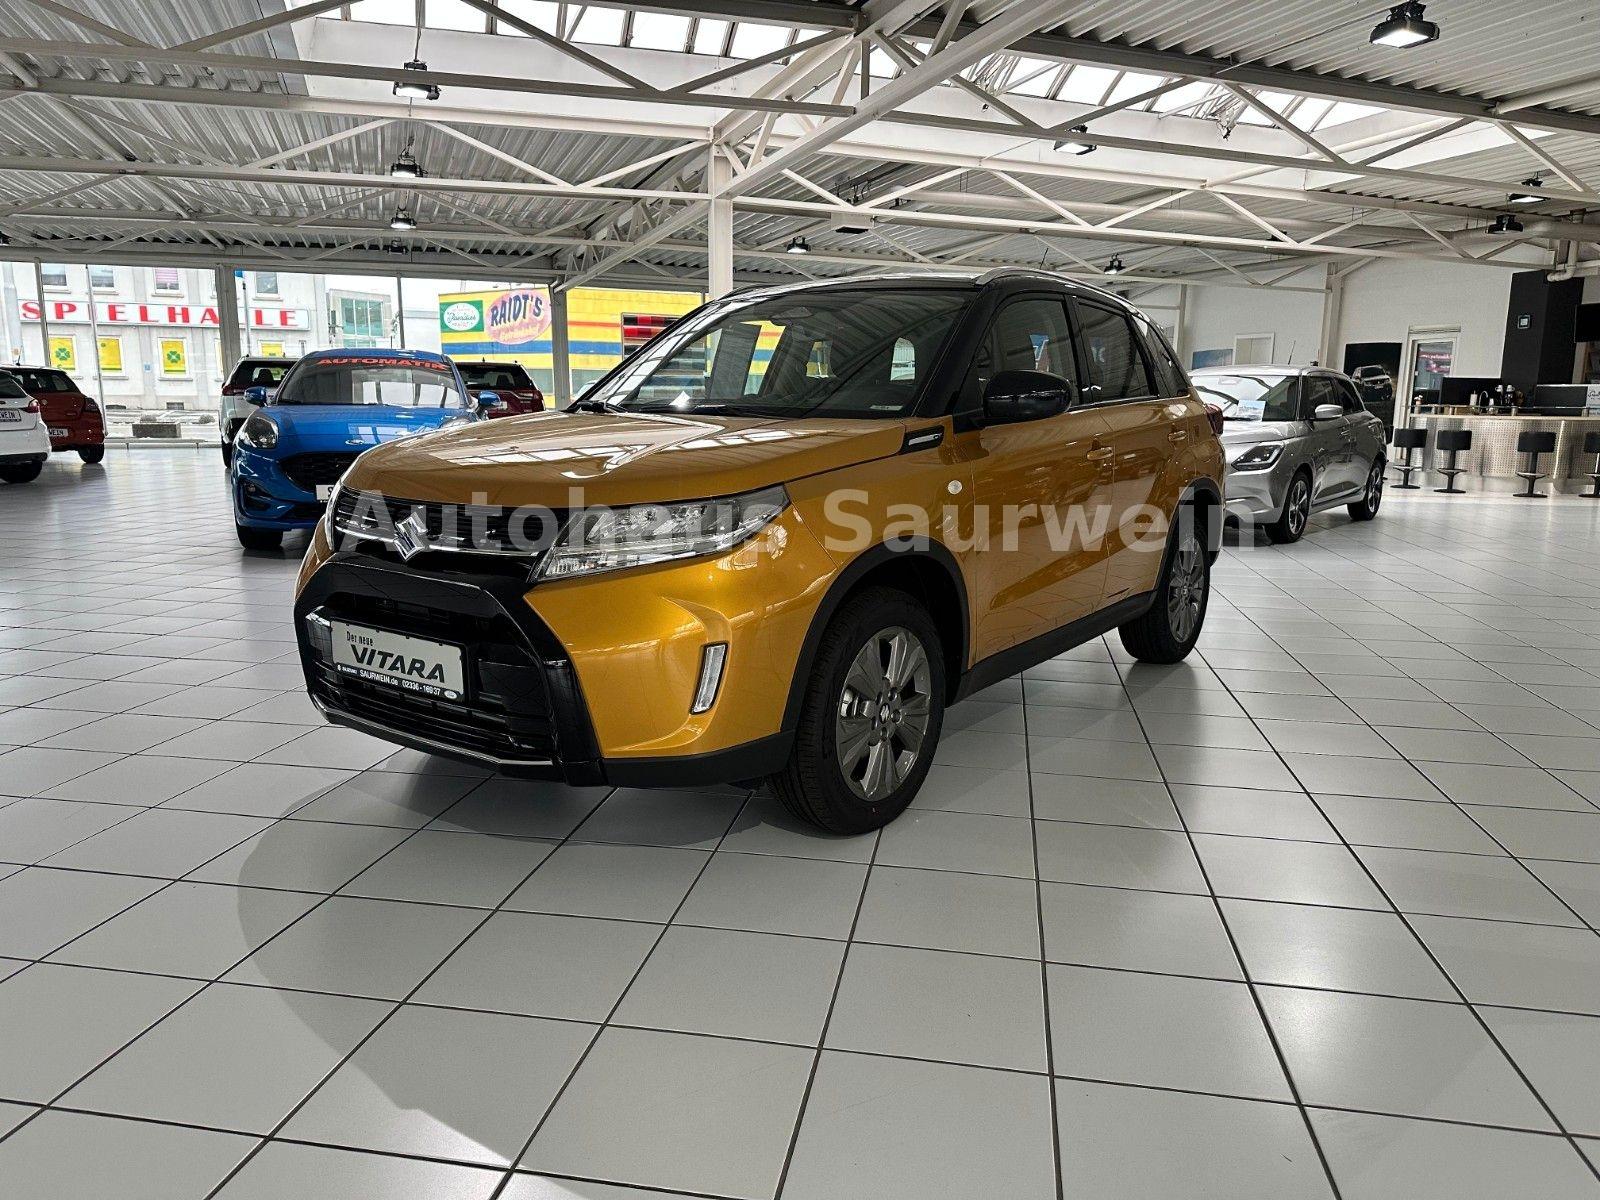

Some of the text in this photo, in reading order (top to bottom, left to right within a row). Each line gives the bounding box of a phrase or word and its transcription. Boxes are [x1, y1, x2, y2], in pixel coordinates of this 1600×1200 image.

[22, 301, 298, 327] SPELHALE
[490, 294, 543, 327] RAIDT'S
[317, 357, 449, 371] AUTOMATIK
[346, 630, 357, 642] Der
[350, 644, 446, 683] VITARA
